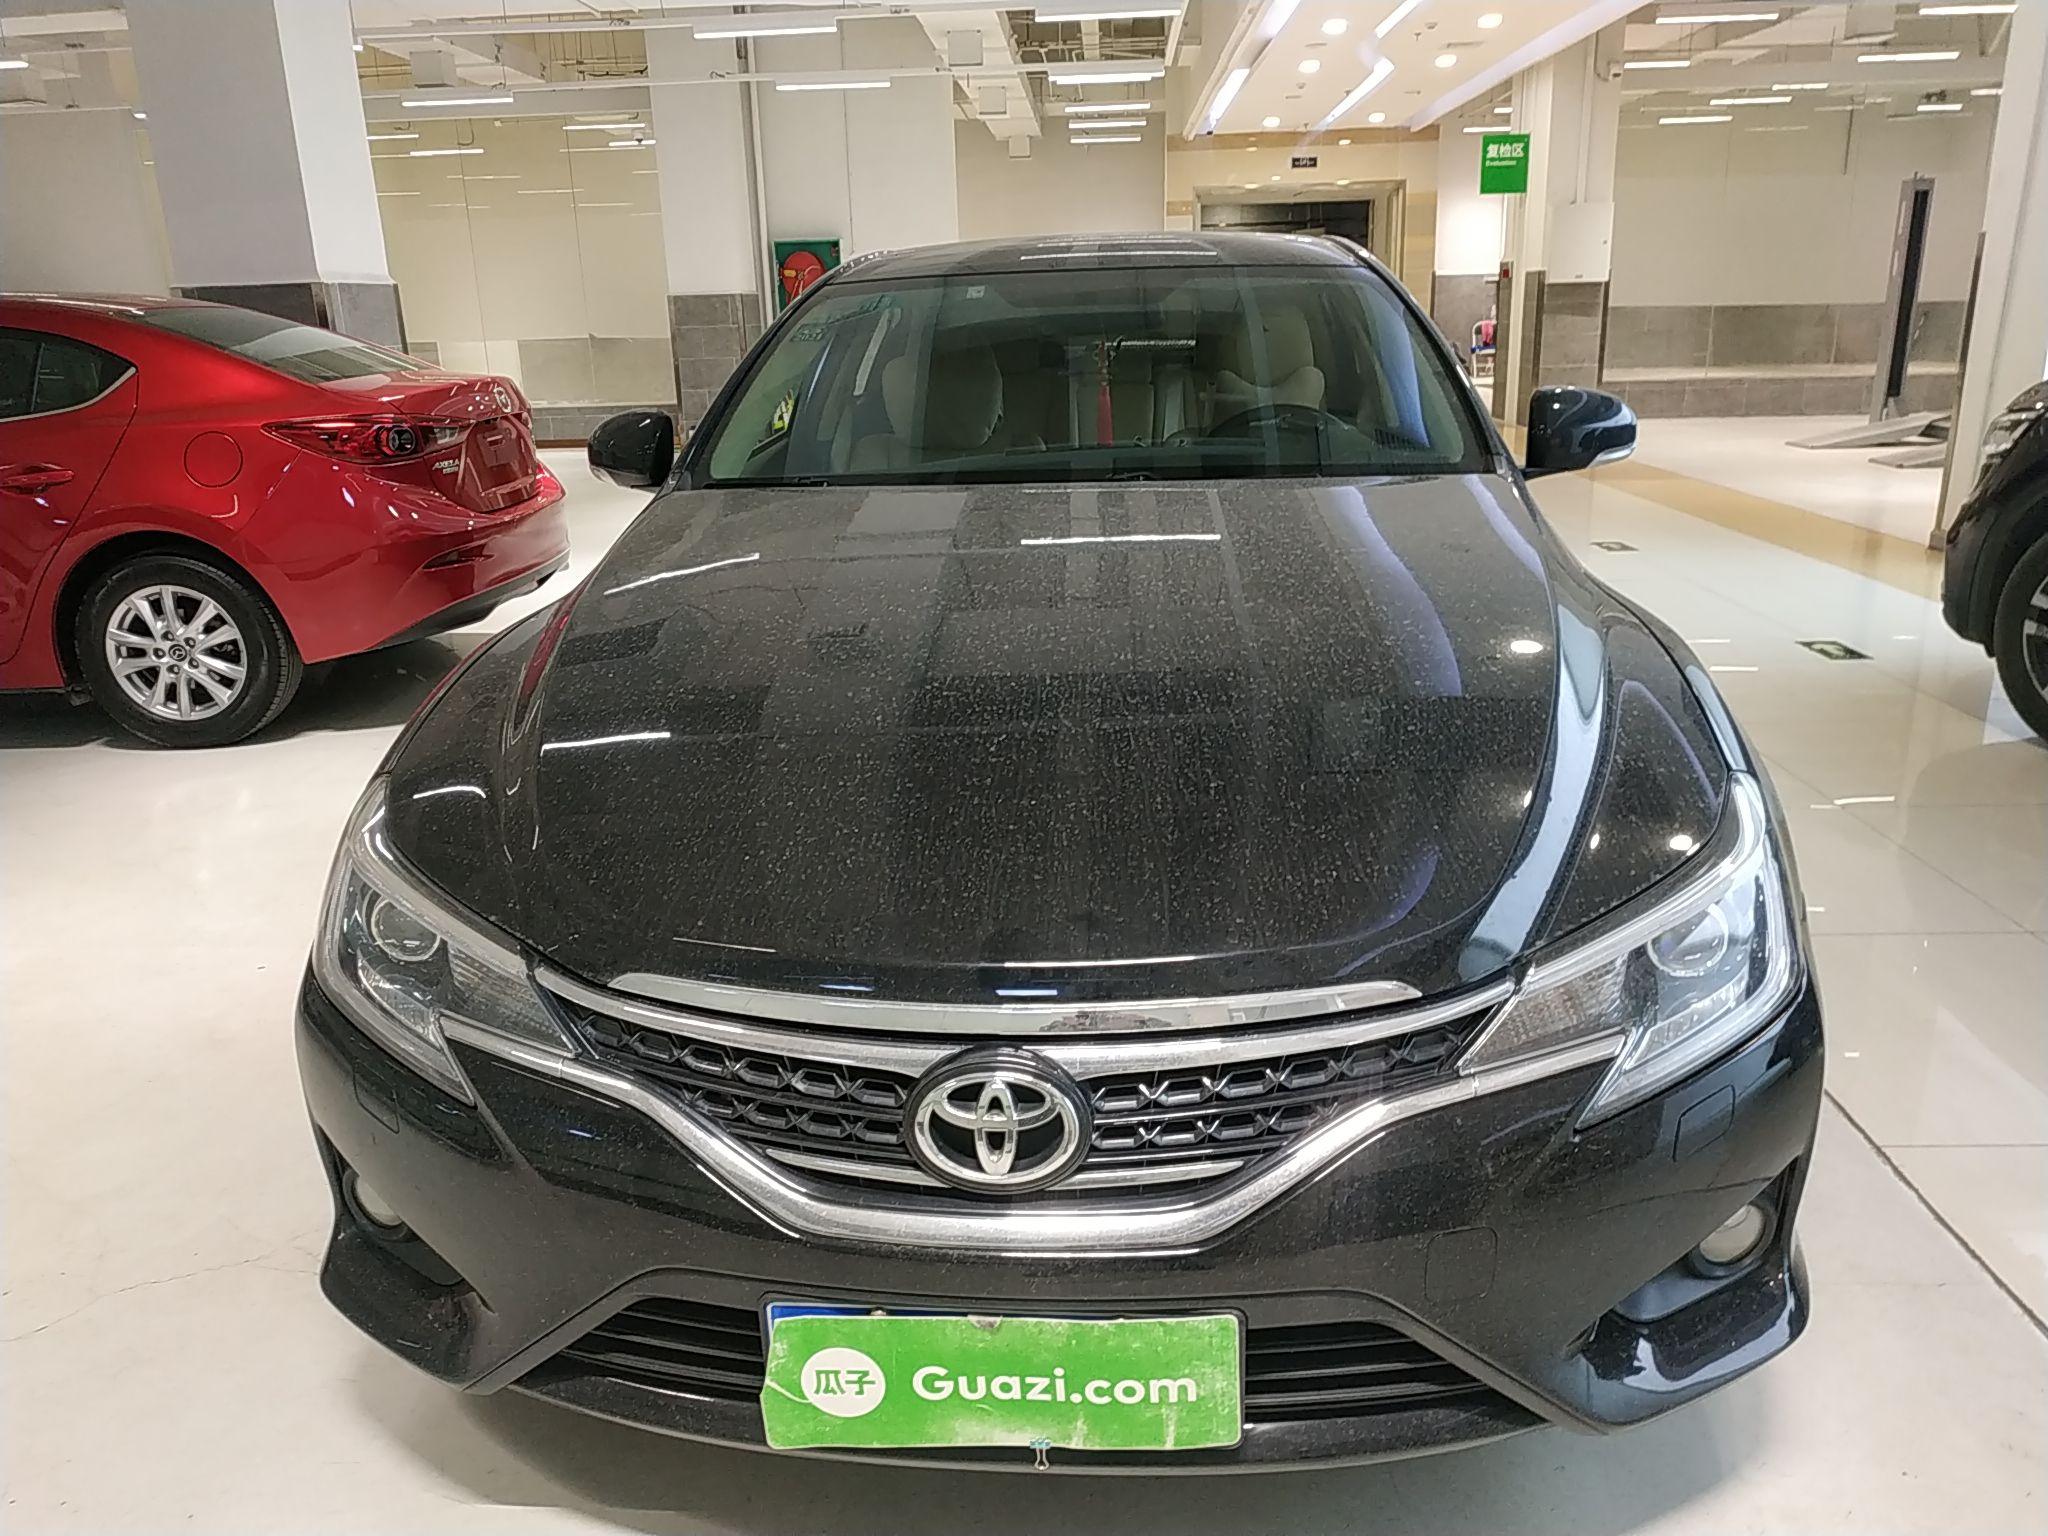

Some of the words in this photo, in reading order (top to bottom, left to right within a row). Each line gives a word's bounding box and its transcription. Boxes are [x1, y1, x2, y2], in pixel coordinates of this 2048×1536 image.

[432, 459, 460, 470] AXELA
[814, 1370, 876, 1395] 瓜子
[912, 1365, 1198, 1404] Guazi.com
